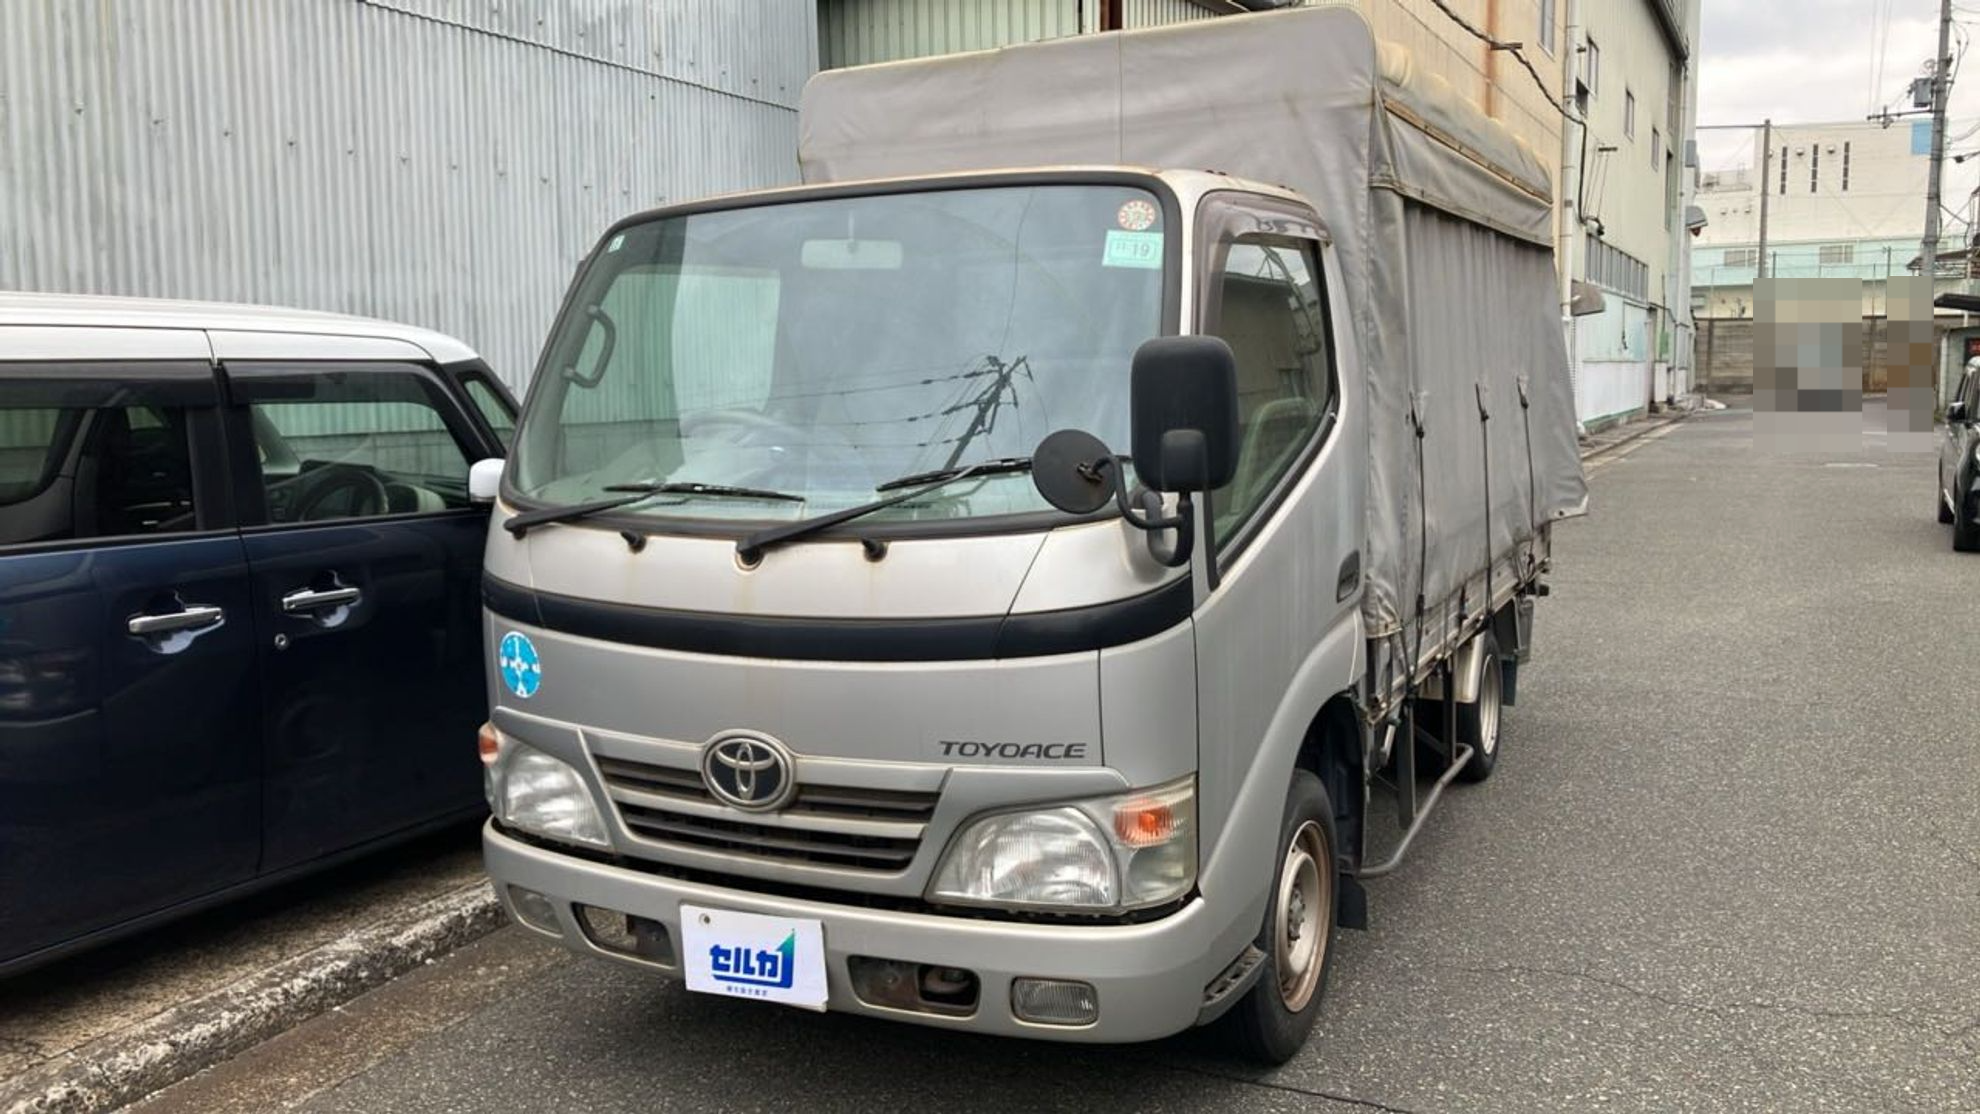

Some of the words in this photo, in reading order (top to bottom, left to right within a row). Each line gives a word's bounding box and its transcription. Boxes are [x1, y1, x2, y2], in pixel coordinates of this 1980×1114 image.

[939, 740, 1087, 759] TOYOACE
[710, 944, 779, 978] セルカ
